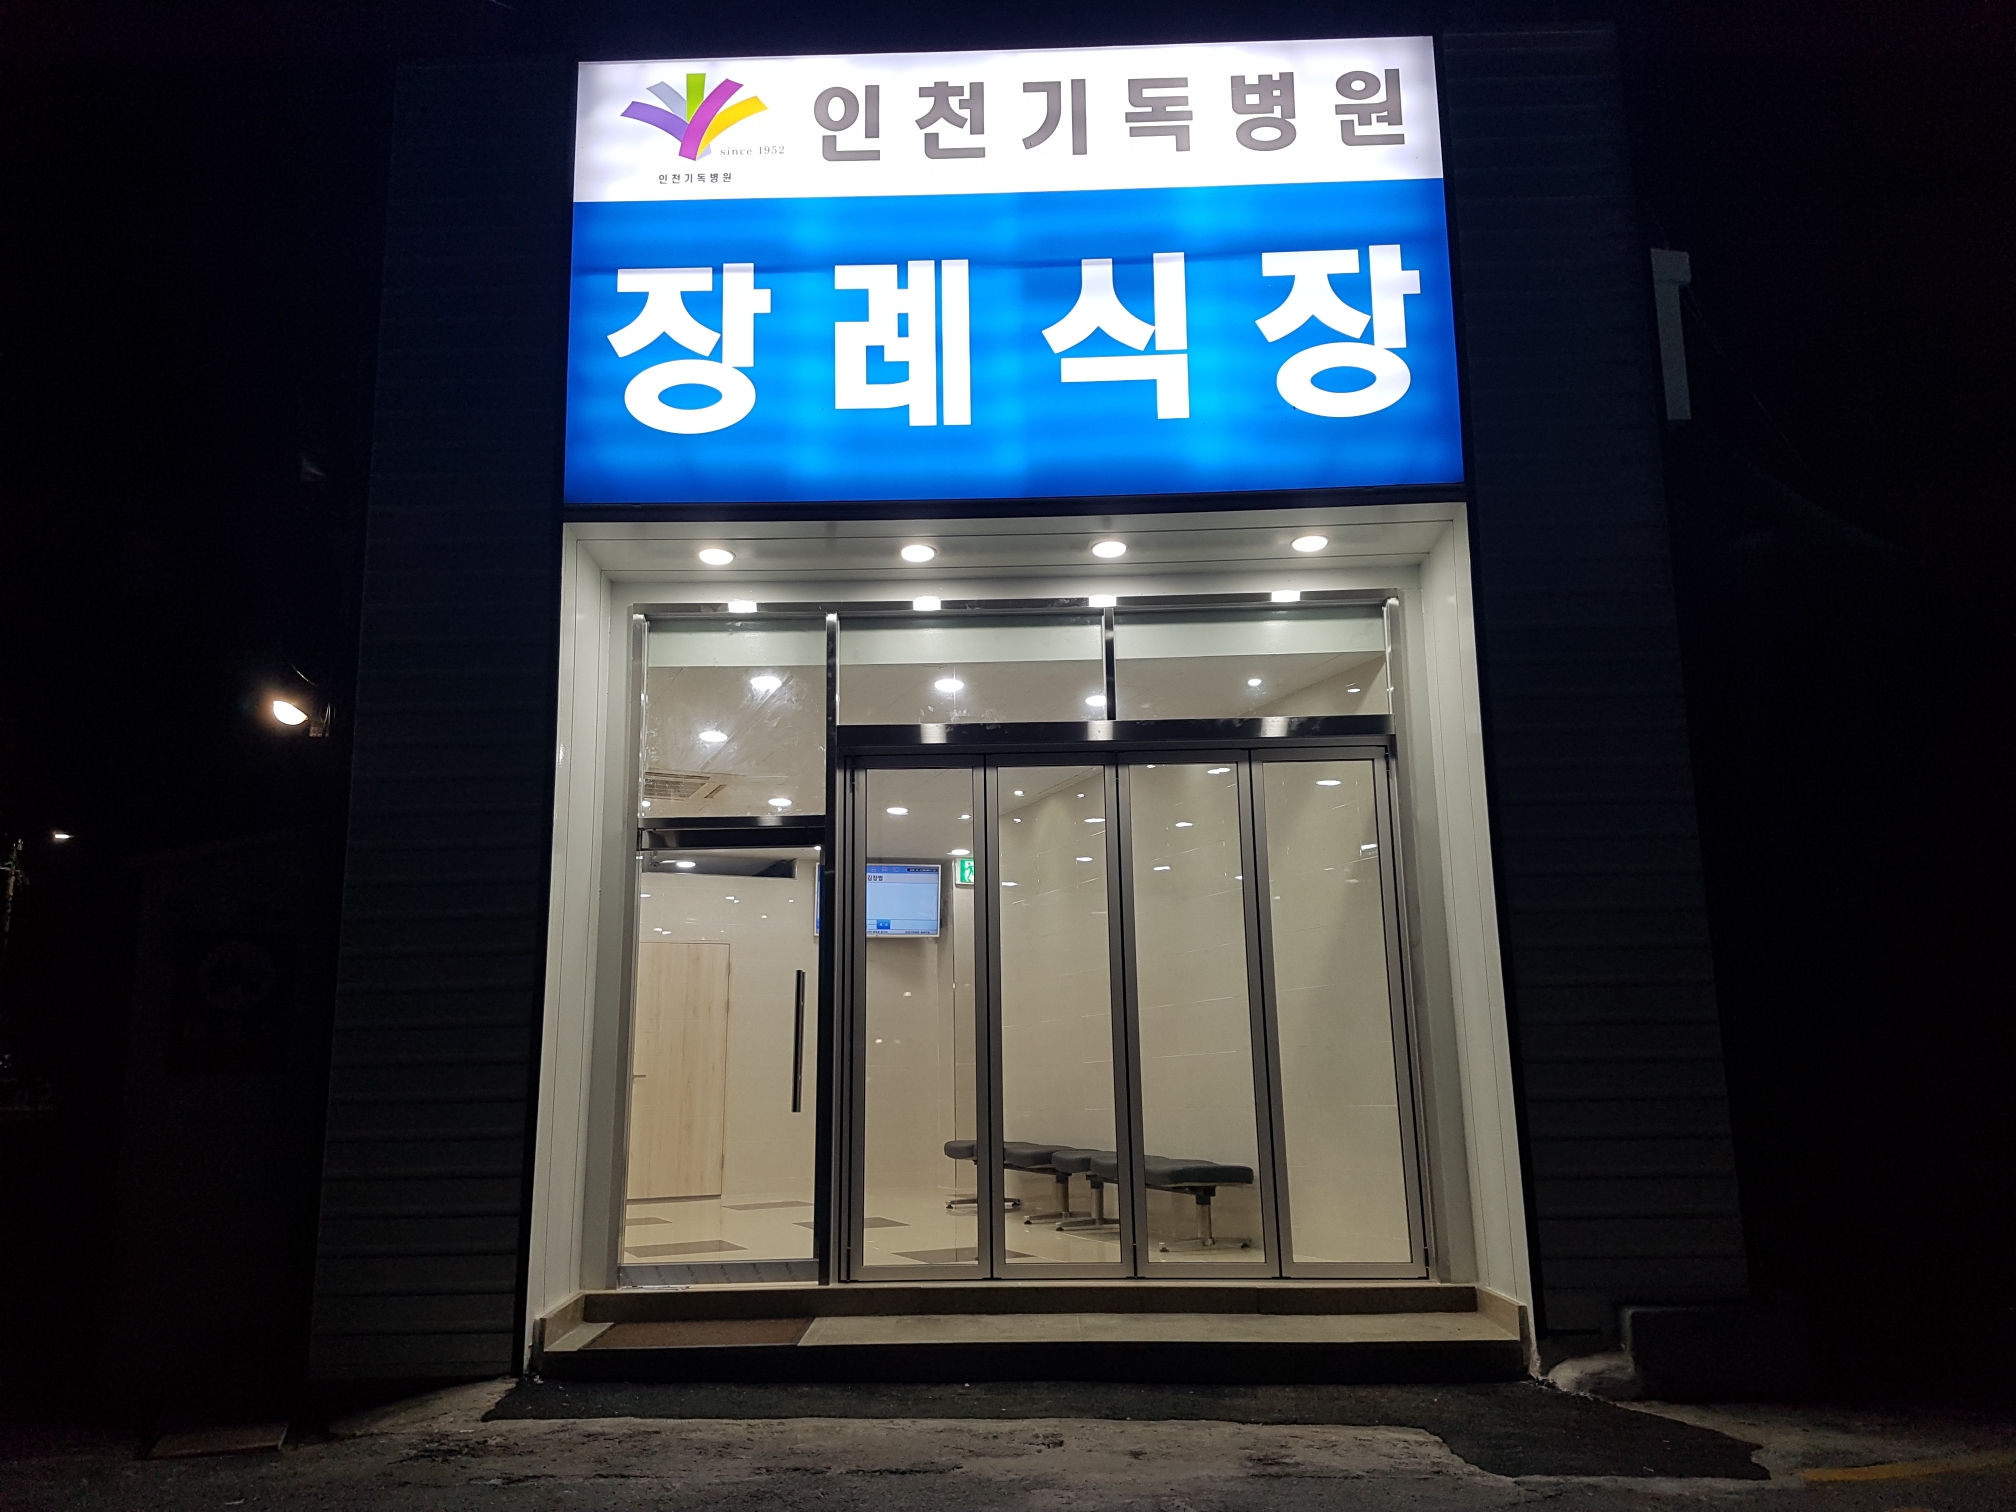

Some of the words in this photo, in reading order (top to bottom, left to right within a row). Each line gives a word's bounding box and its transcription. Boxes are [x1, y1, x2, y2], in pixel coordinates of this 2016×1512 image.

[814, 69, 1405, 161] 인천기독병원
[720, 146, 753, 156] since
[758, 145, 786, 155] 1952
[658, 172, 732, 185] 인천기독병원
[608, 245, 1420, 433] 장례식장
